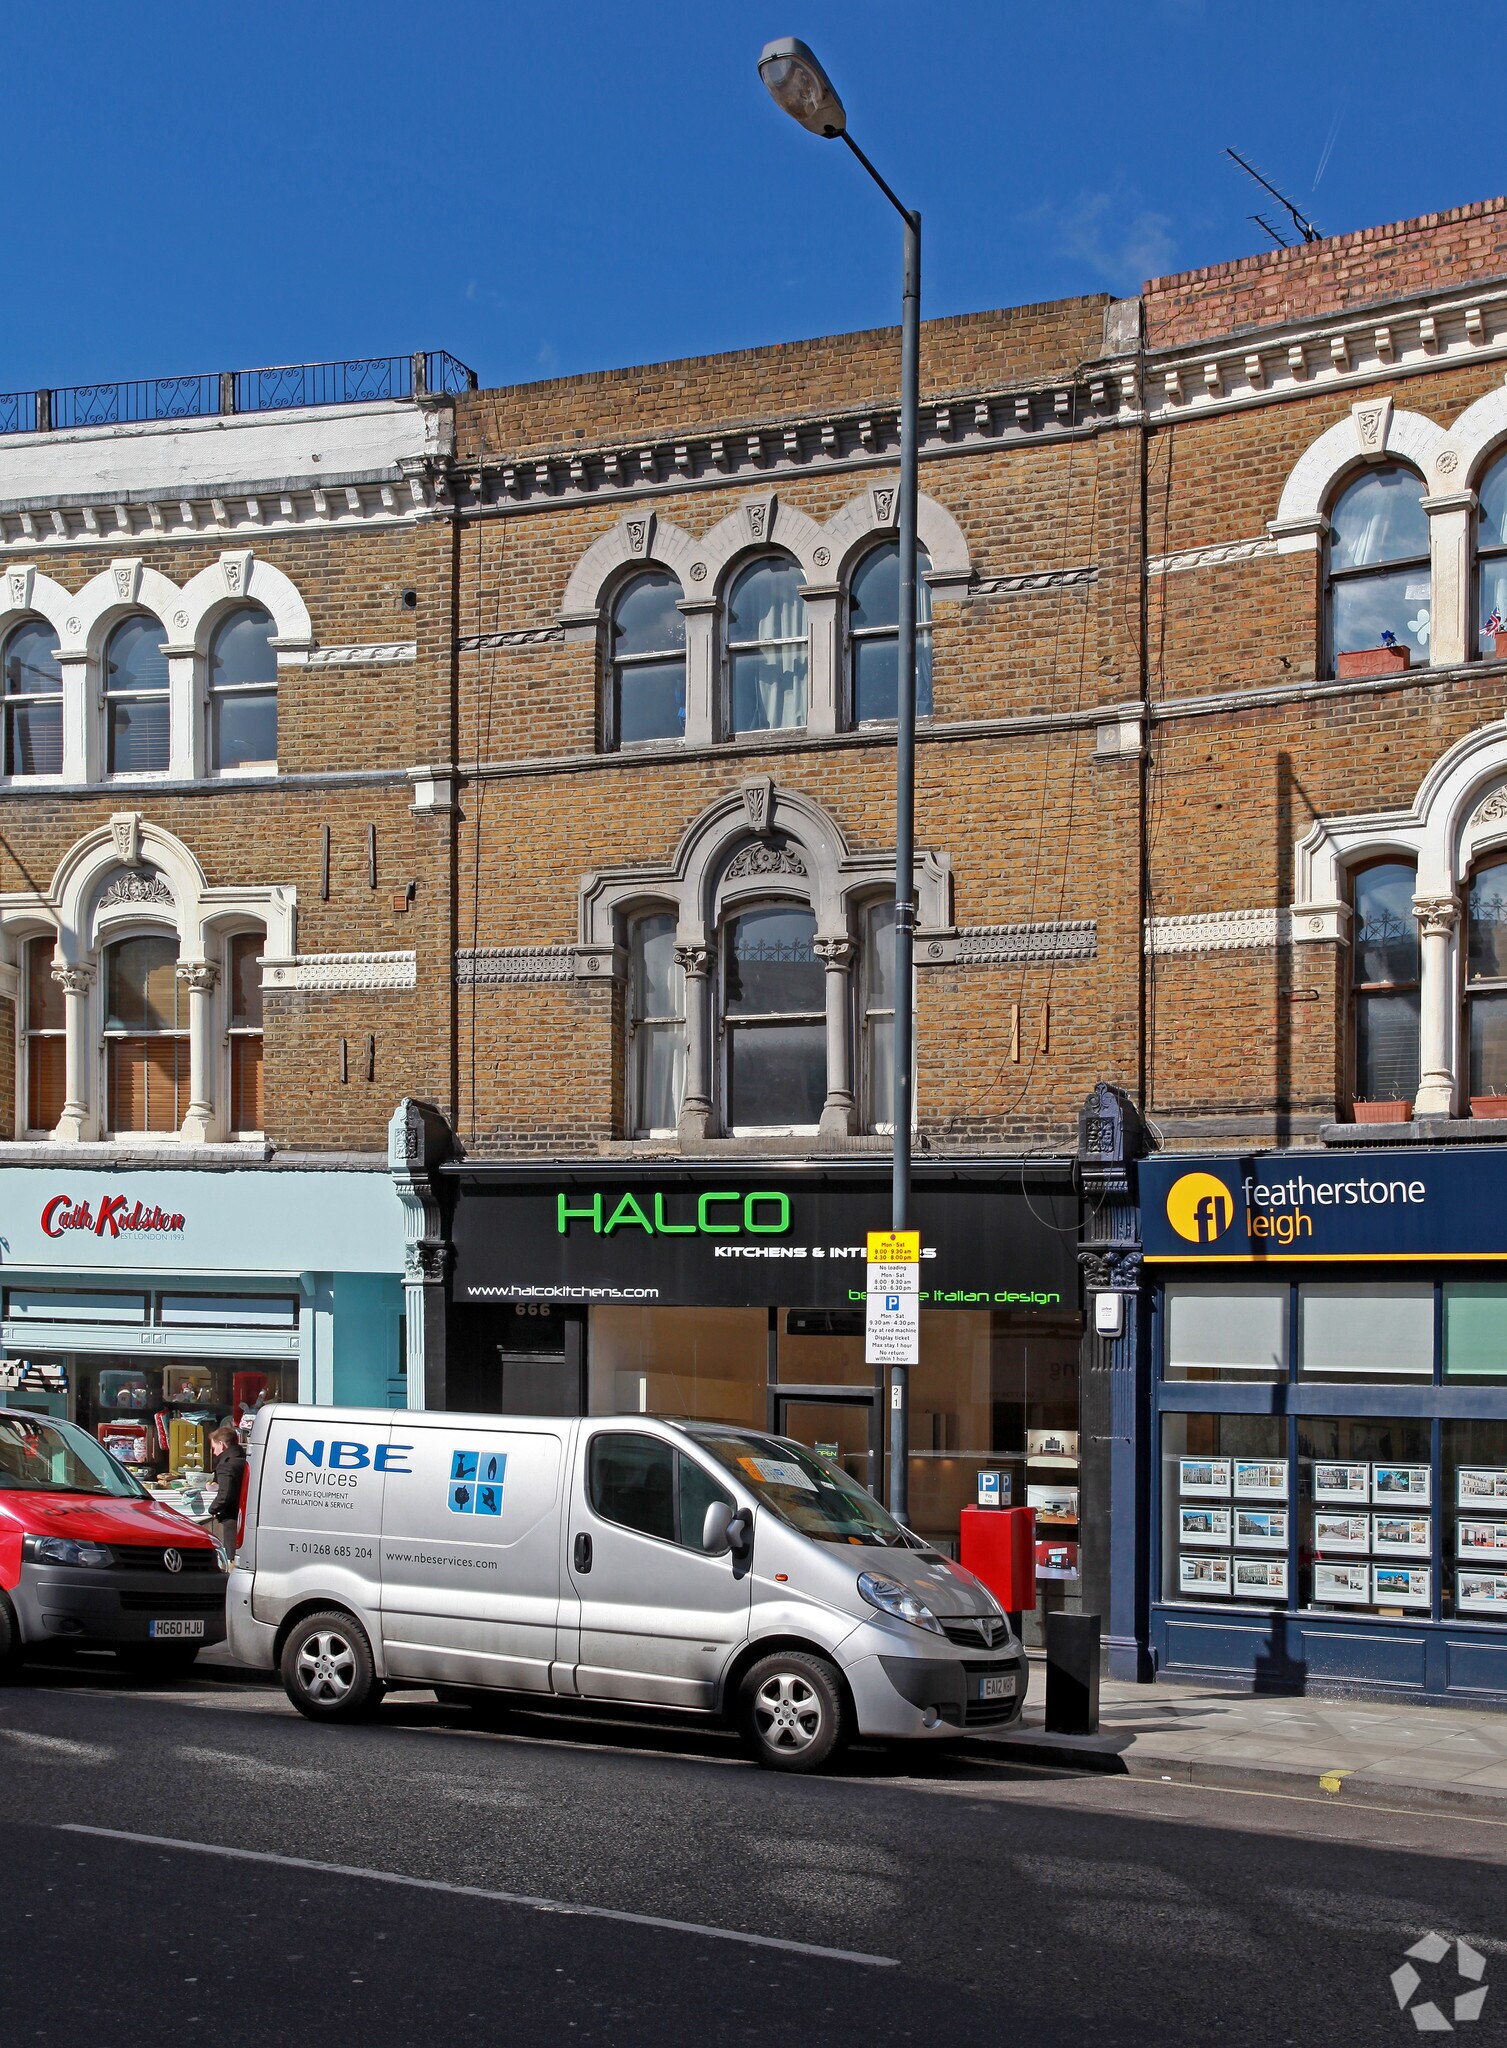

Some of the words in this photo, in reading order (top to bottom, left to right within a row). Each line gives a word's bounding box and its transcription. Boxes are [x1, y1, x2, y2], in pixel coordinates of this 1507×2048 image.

[1242, 1176, 1425, 1206] featherstone
[41, 1194, 96, 1238] Cath
[94, 1194, 186, 1239] Kidston
[557, 1191, 791, 1234] HALCO
[1246, 1207, 1313, 1244] leigh
[714, 1246, 808, 1258] KITCHENS
[812, 1246, 826, 1258] &
[467, 1285, 659, 1298] www.halcokitchens.com
[934, 1290, 989, 1302] italian
[994, 1290, 1060, 1305] design
[515, 1303, 550, 1316] 666
[889, 1297, 898, 1310] P
[285, 1438, 415, 1473] NBE
[284, 1468, 358, 1488] services
[982, 1474, 995, 1491] P
[281, 1488, 312, 1497] CATERING
[313, 1490, 349, 1499] EQUIPMENT
[280, 1498, 324, 1507] INSTALLATION
[330, 1501, 354, 1509] SERVICE
[289, 1543, 299, 1552] T:
[301, 1543, 331, 1555] 01268
[334, 1546, 351, 1557] 685
[355, 1547, 372, 1558] 204
[386, 1552, 498, 1570] www.nbeservices.com
[156, 1621, 183, 1635] HG60
